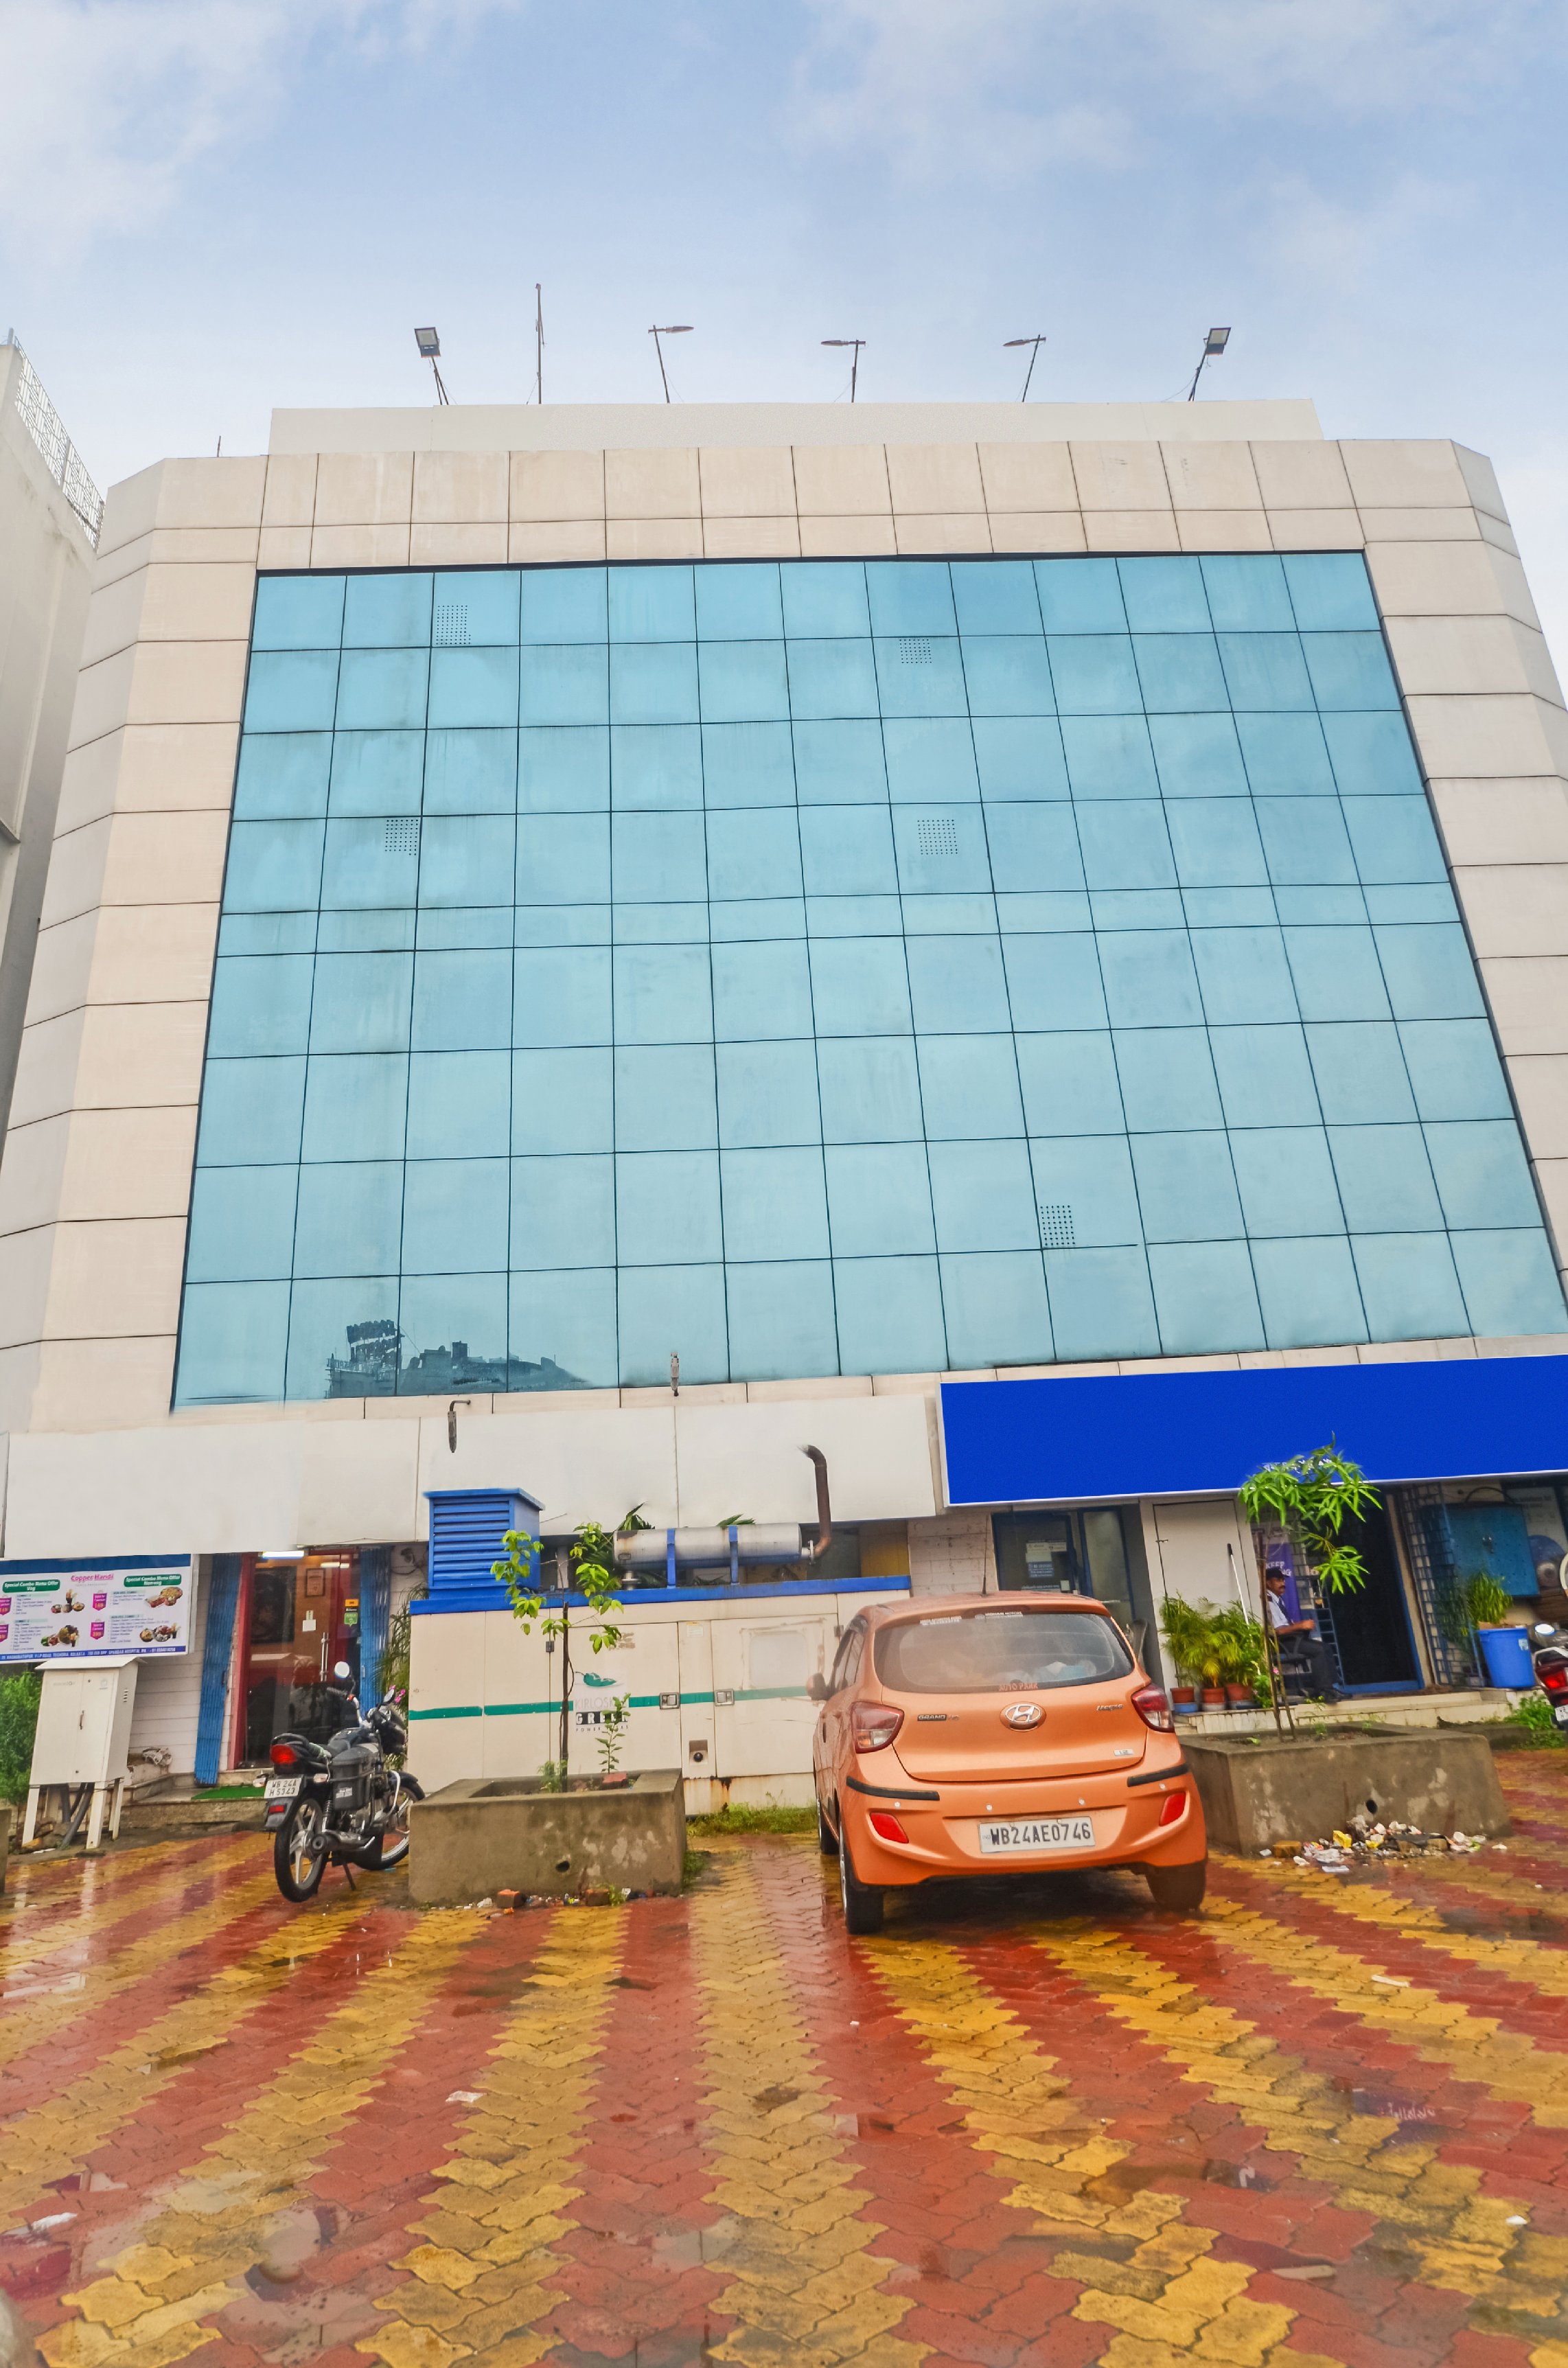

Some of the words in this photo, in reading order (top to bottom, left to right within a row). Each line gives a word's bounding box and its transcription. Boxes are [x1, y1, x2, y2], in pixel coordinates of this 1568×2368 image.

[999, 1683, 1017, 1692] AUTO
[1019, 1682, 1038, 1690] PARK
[575, 1697, 615, 1710] KIRLOSK
[991, 1821, 1091, 1846] WB24AE0746
